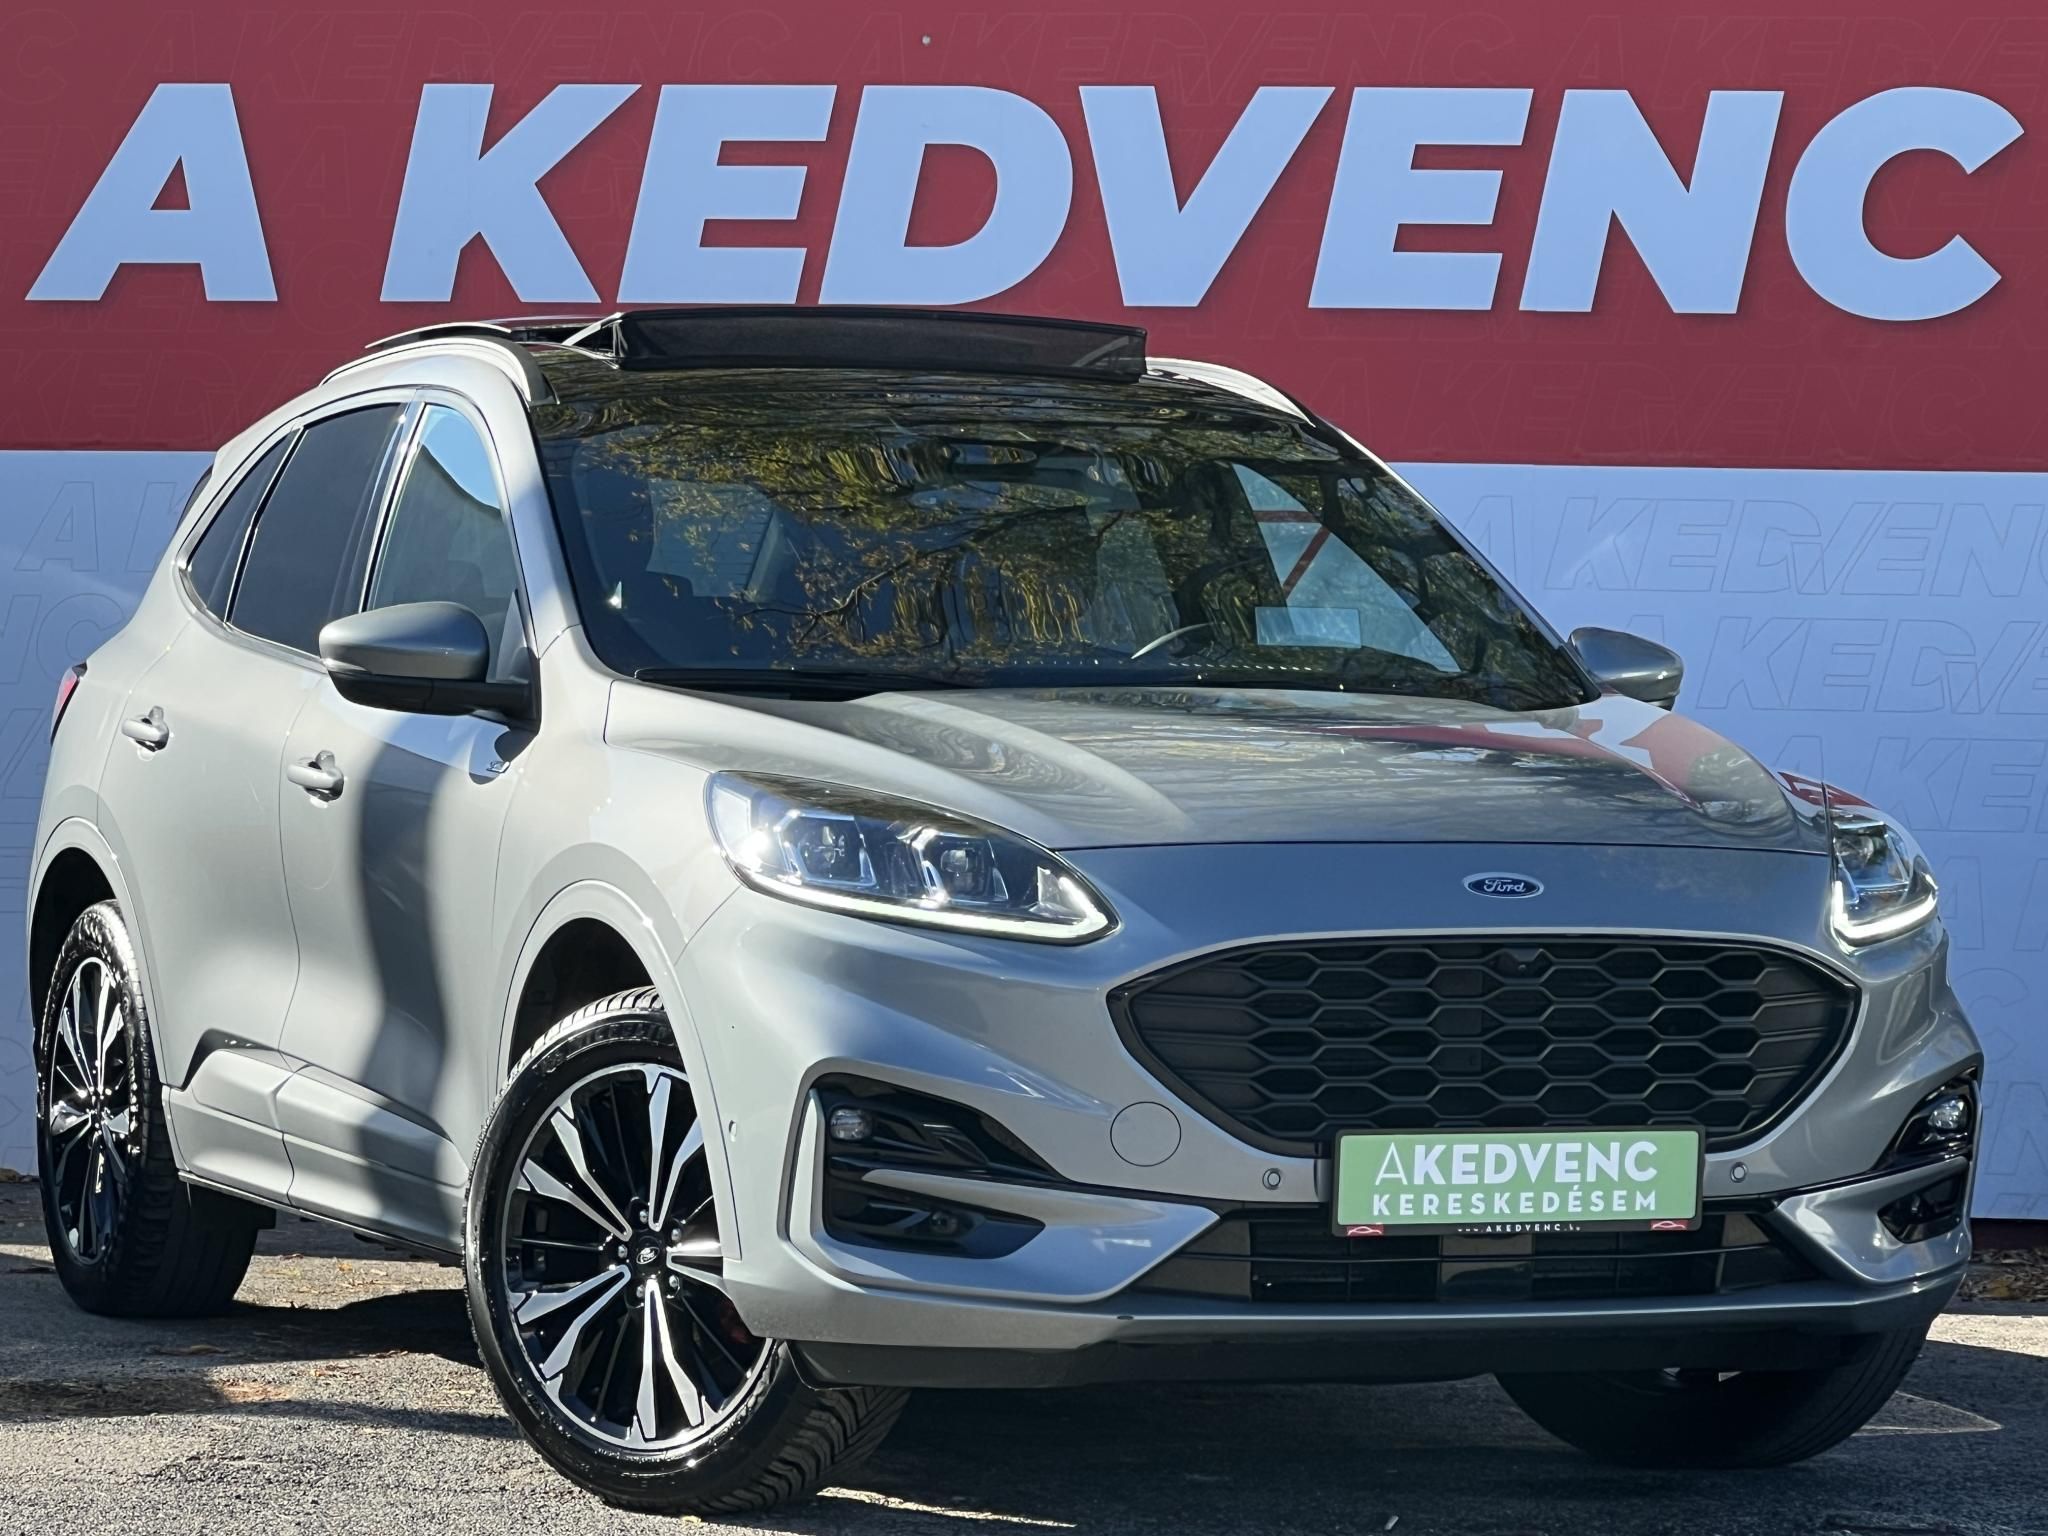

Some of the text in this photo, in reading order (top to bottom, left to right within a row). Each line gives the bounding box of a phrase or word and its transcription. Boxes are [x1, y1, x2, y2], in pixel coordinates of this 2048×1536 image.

[27, 82, 278, 303] A
[380, 82, 2025, 322] KEDVENC
[1544, 496, 2048, 598] KEDVEN
[1483, 879, 1526, 893] Ford
[1373, 1185, 1657, 1217] KERESKEDÉSEM
